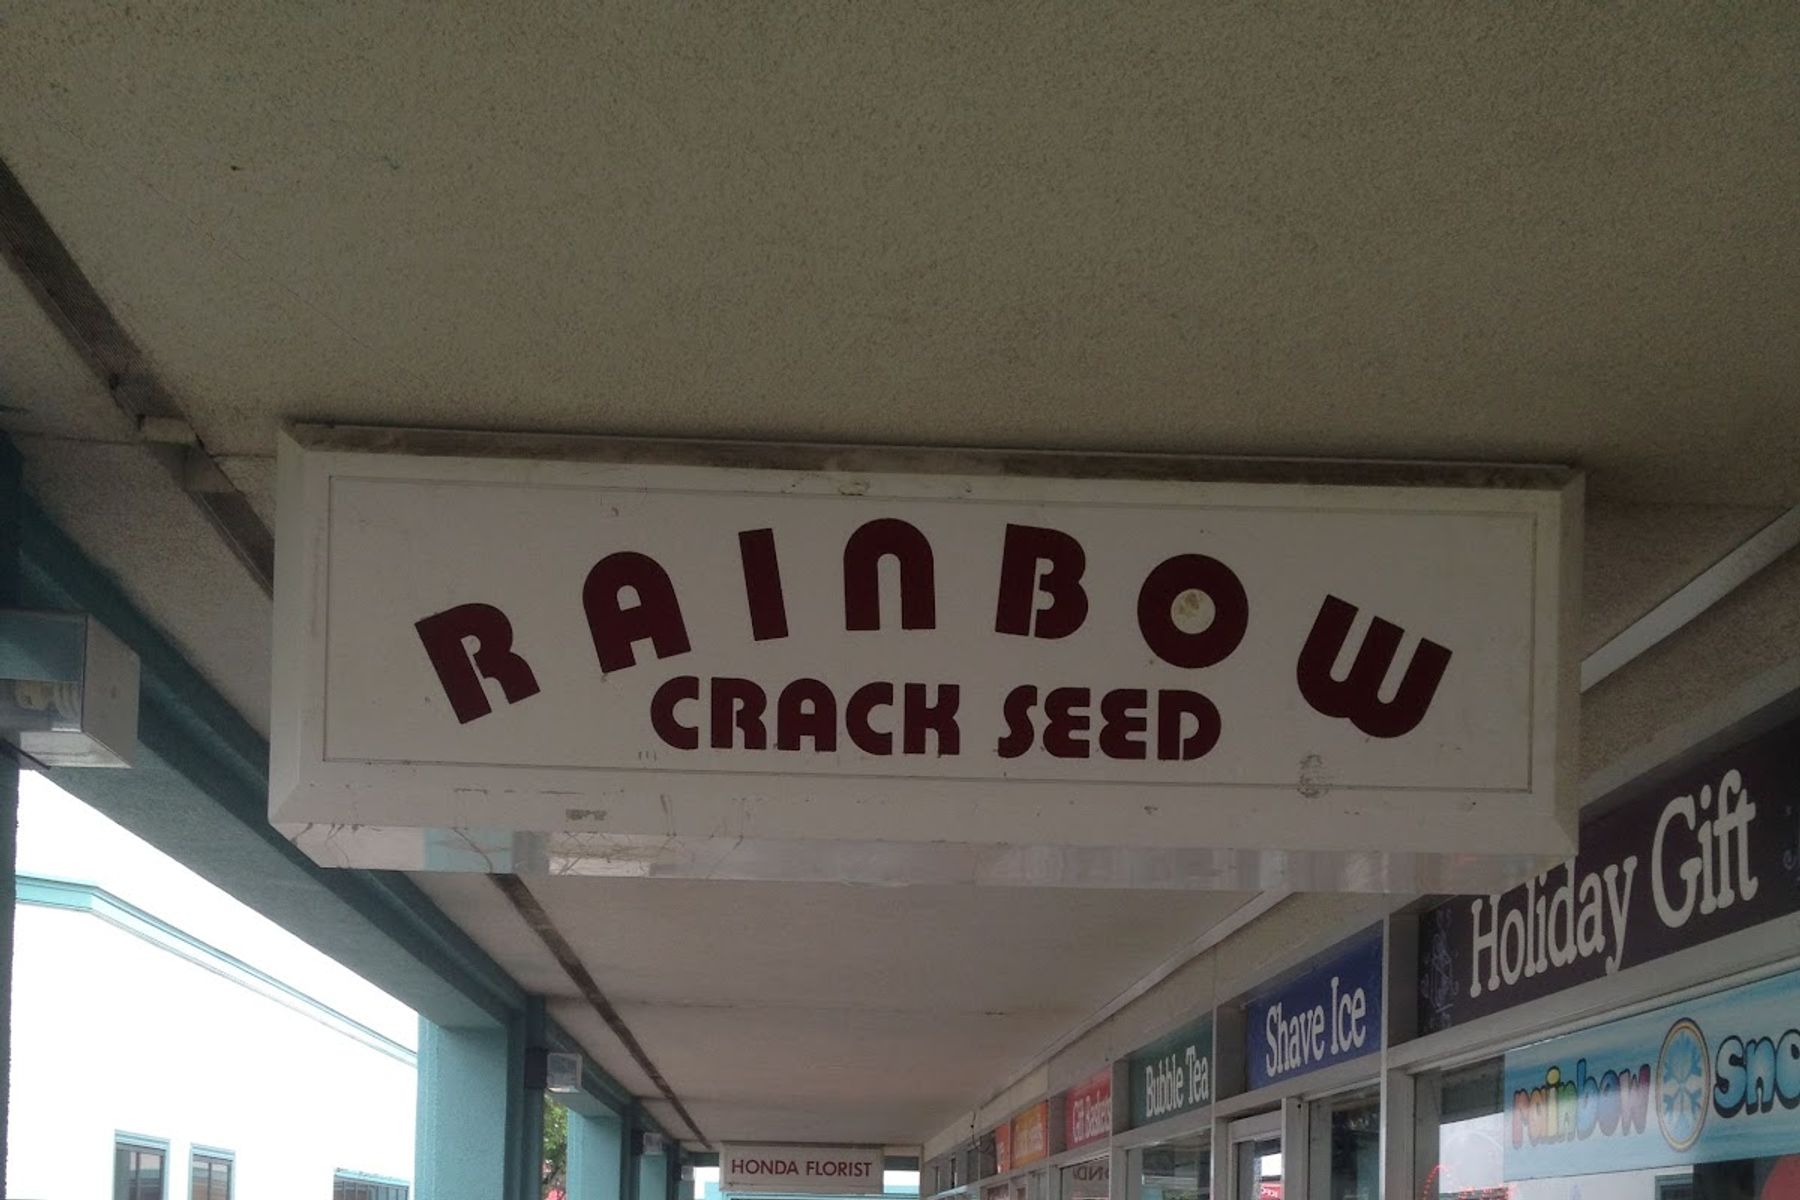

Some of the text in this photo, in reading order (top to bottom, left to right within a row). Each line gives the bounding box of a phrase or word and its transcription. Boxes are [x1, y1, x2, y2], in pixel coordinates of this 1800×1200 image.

[415, 517, 1453, 740] RAINBOW
[649, 675, 1223, 762] CRACK SEED
[1469, 769, 1759, 999] Holiday Gift
[1265, 976, 1367, 1078] Shave Ice
[1145, 1045, 1209, 1118] Bubble Tea
[1511, 1058, 1650, 1150] rainbow
[732, 1159, 873, 1177] HONDA FLORIST
